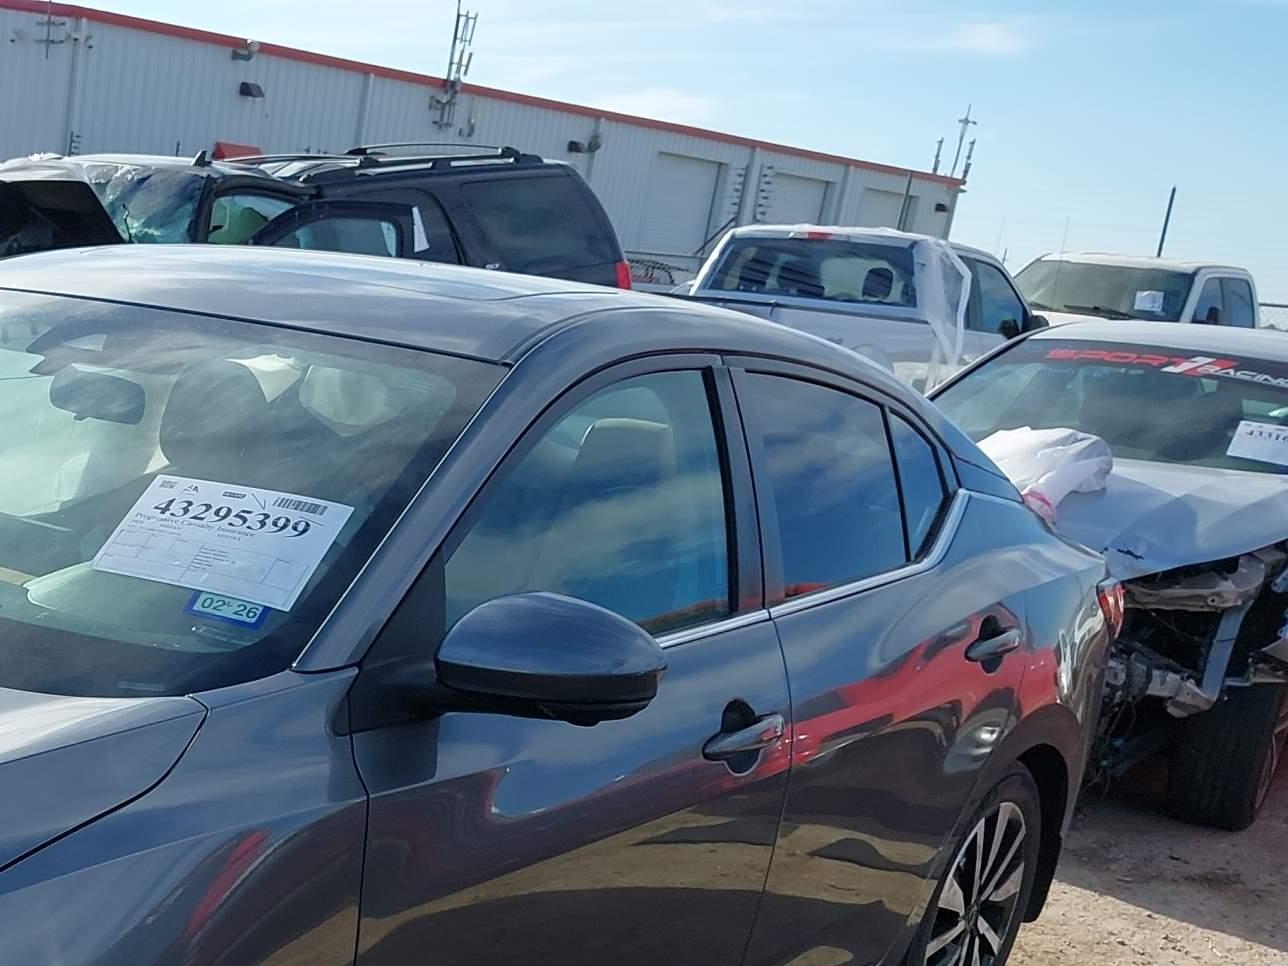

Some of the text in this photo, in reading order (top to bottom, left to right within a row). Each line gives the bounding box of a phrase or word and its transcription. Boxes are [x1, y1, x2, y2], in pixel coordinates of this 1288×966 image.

[153, 497, 312, 538] 43295399
[201, 597, 261, 619] 02 26
